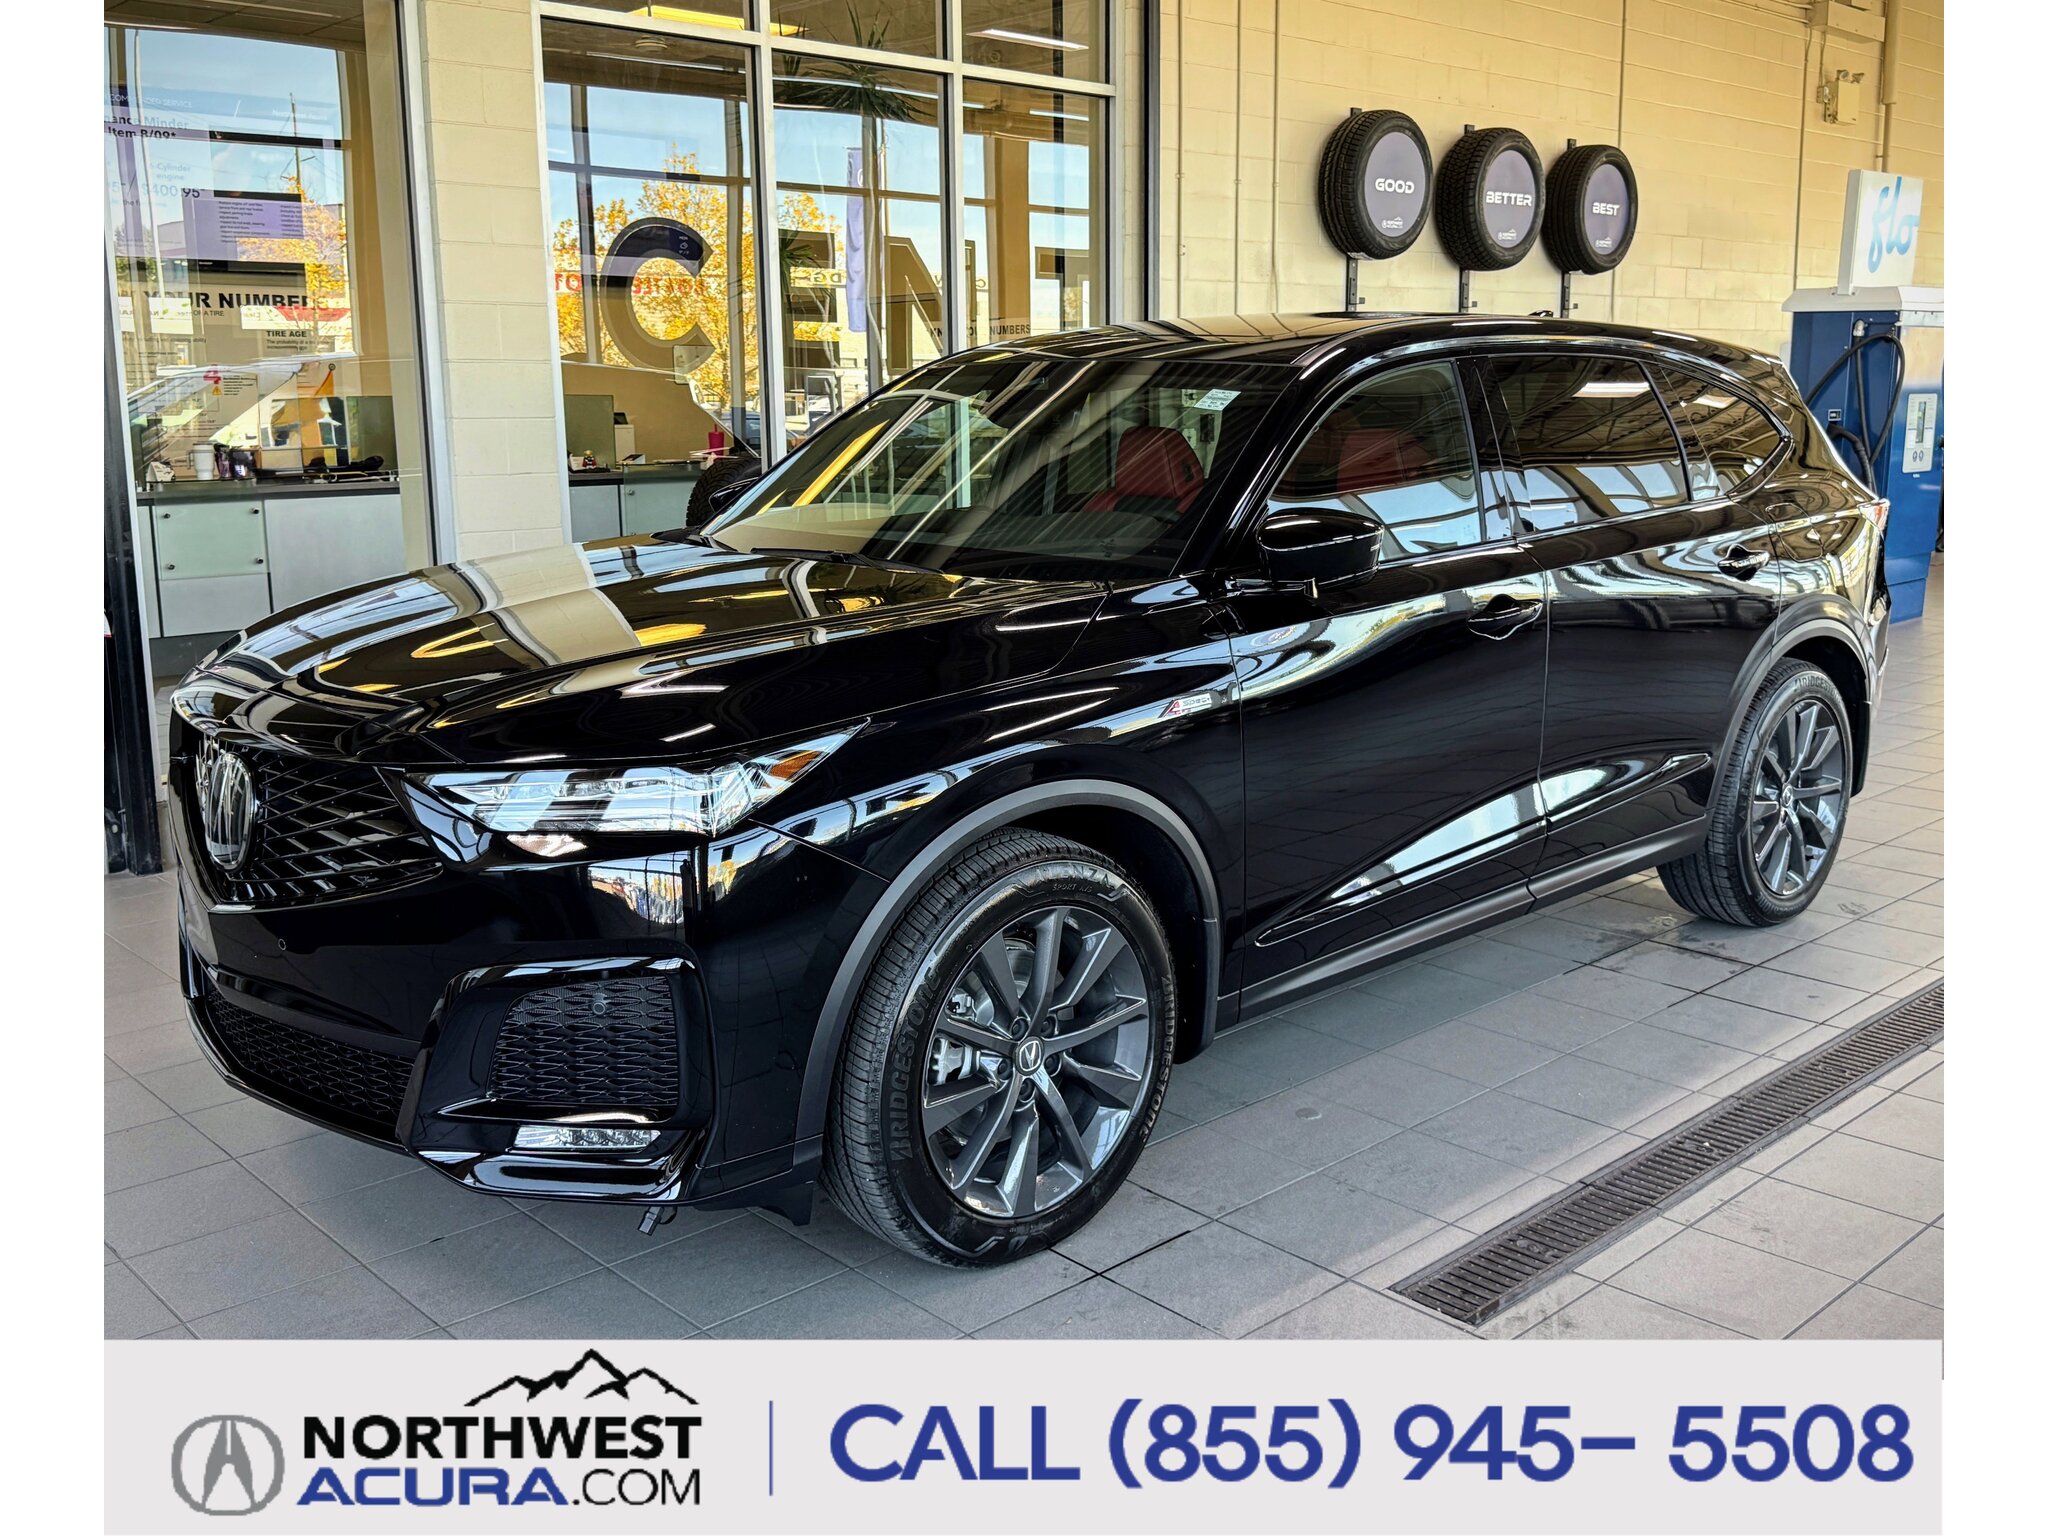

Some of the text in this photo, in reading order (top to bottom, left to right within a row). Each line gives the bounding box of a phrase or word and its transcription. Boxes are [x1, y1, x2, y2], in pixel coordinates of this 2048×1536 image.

[1375, 178, 1414, 194] GOOD
[1486, 191, 1532, 207] BETTER
[1593, 202, 1619, 216] BEST
[266, 330, 307, 338] TIRE AGE
[989, 324, 1031, 336] NUMBERS
